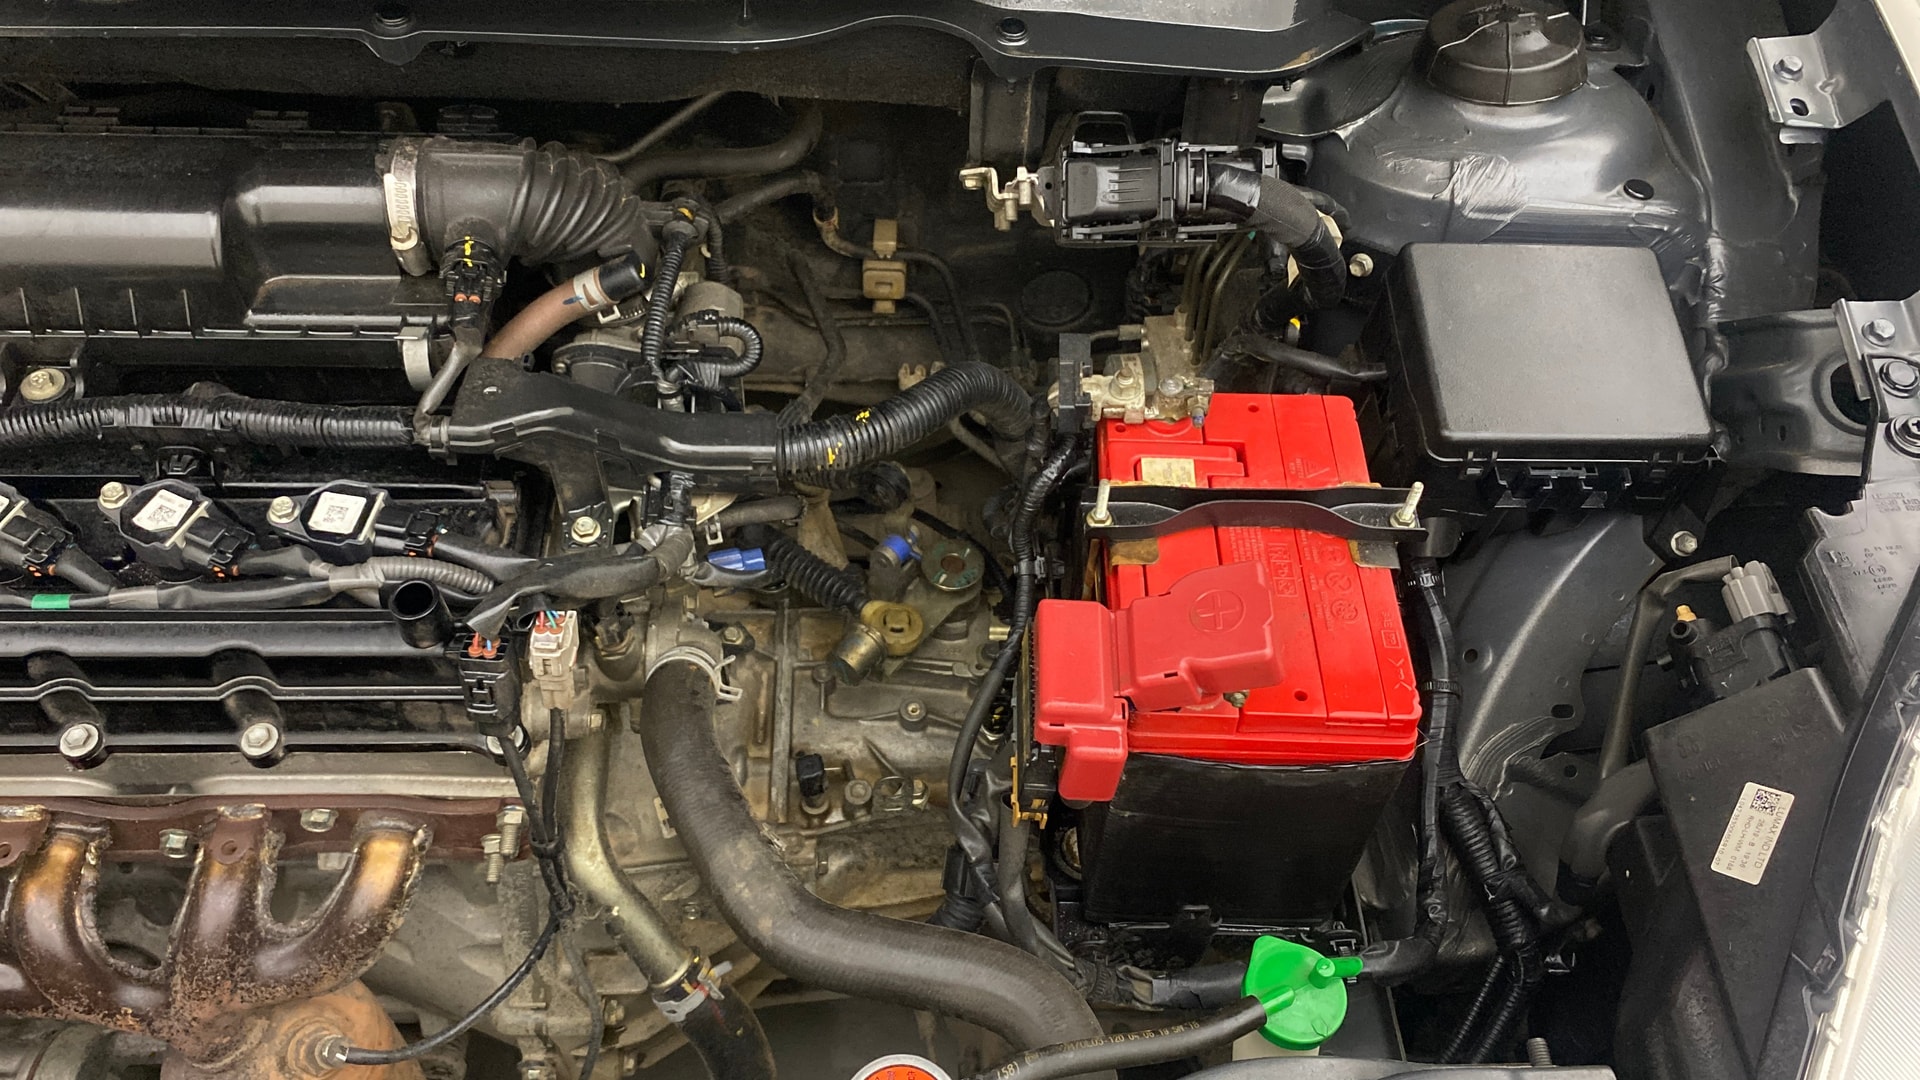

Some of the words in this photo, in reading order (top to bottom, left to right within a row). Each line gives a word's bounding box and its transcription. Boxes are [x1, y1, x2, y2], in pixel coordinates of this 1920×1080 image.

[1769, 807, 1786, 834] LUMAX
[1762, 836, 1774, 852] IND
[1754, 853, 1766, 869] LTD
